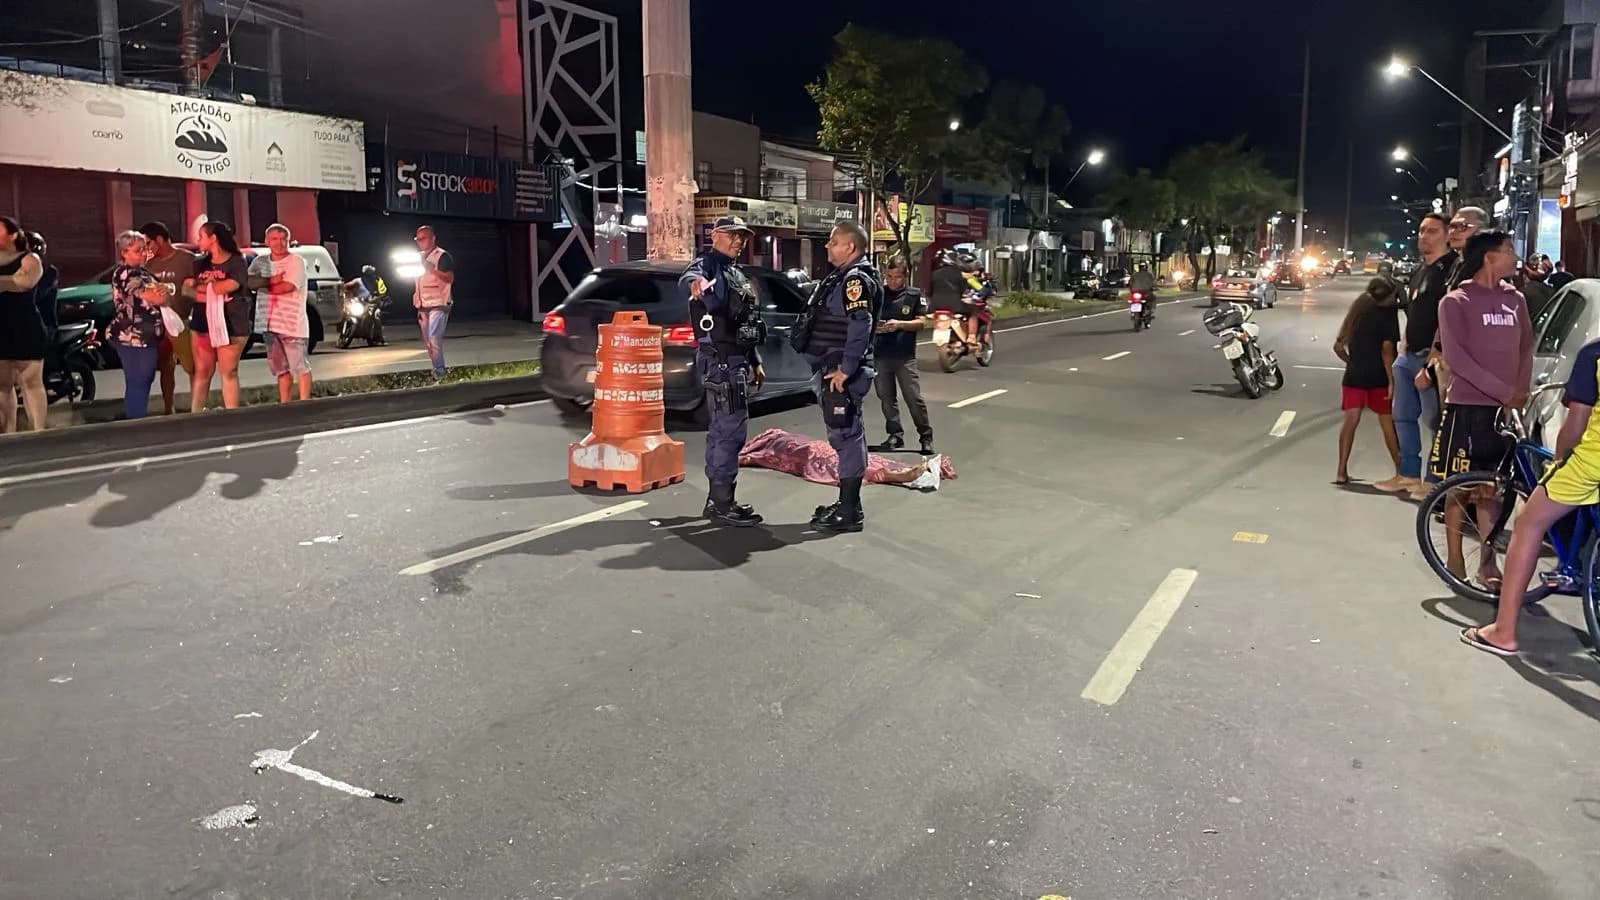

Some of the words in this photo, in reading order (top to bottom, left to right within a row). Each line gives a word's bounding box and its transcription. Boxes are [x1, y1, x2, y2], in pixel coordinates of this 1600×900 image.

[170, 101, 231, 122] ATACADÃO
[177, 152, 193, 168] DO
[198, 157, 231, 174] TRIGO
[846, 300, 868, 311] LESTE
[1482, 313, 1515, 326] PUMA
